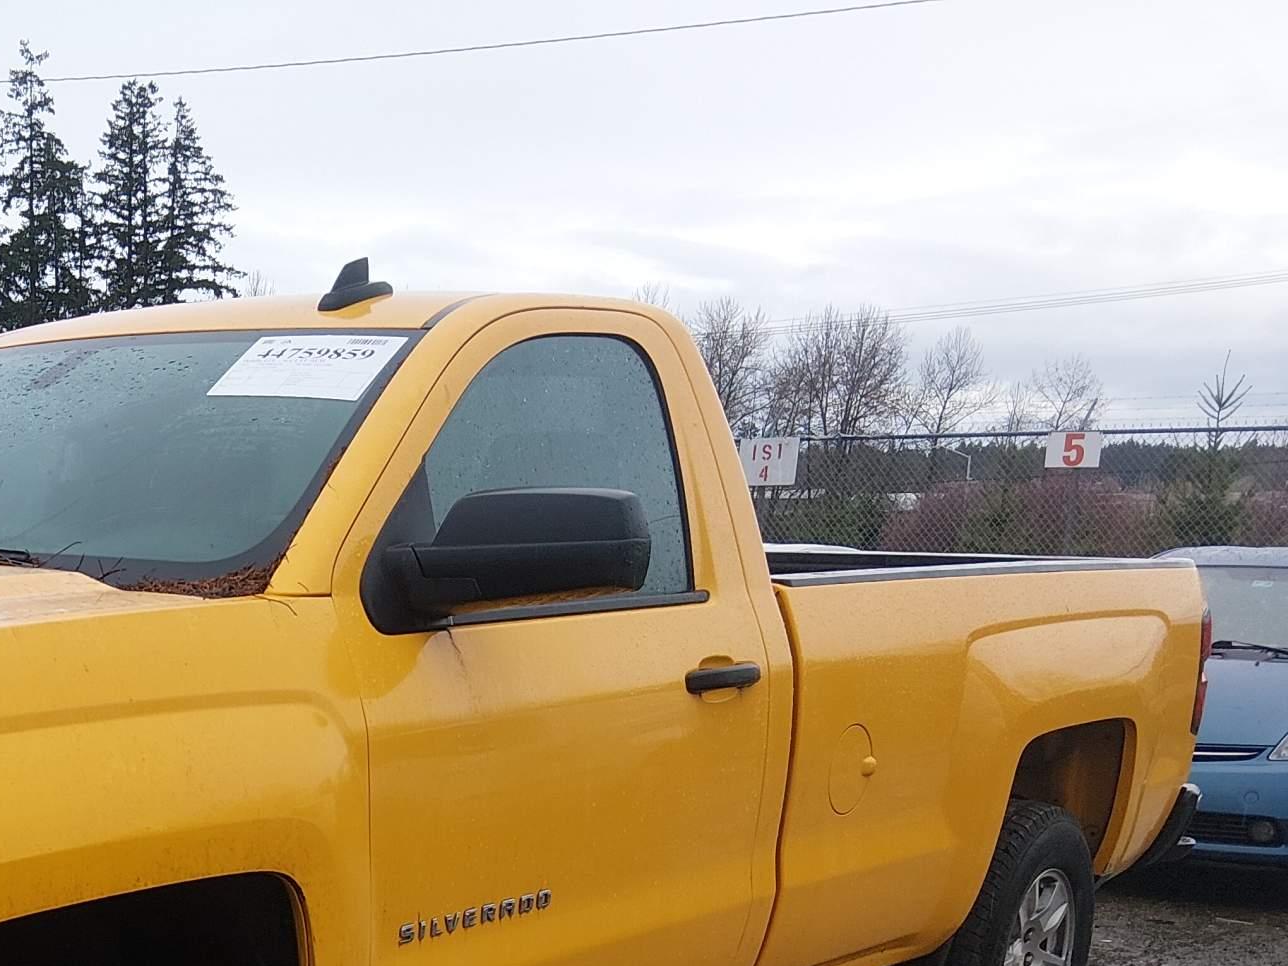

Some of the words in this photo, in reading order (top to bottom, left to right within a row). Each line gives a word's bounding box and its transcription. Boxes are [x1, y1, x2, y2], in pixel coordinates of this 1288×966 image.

[257, 347, 375, 360] 44759859
[1062, 433, 1085, 467] 5
[759, 465, 768, 481] 4
[398, 888, 552, 944] SILVERADO
